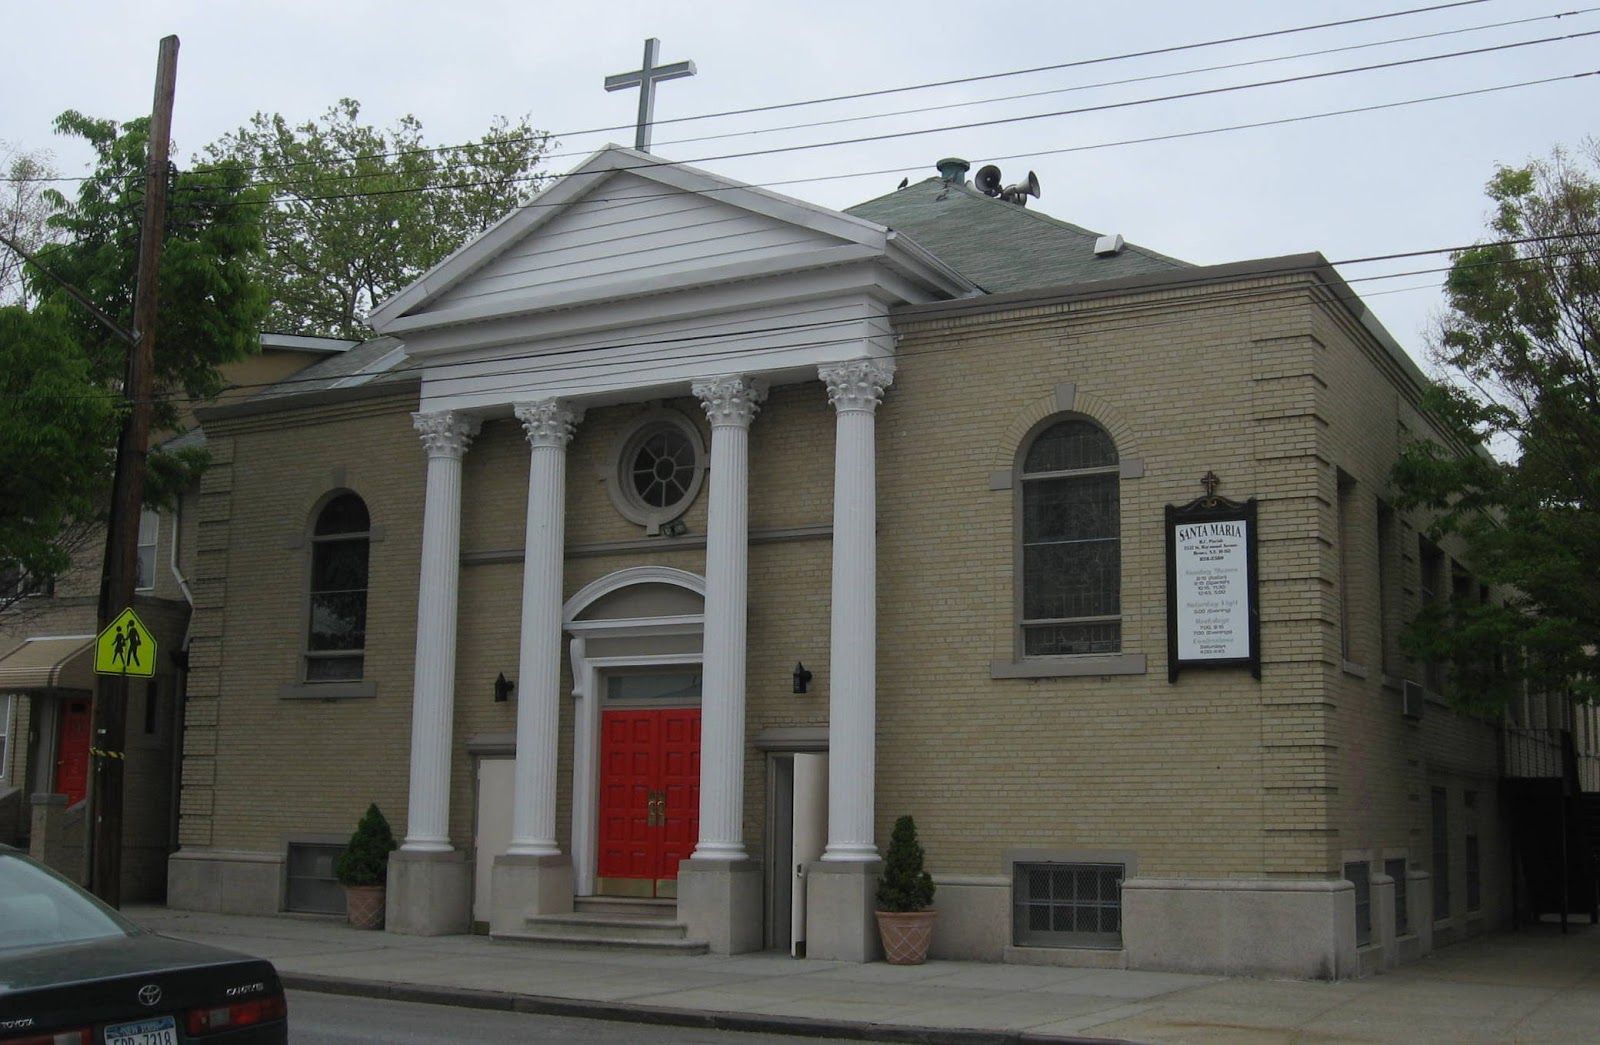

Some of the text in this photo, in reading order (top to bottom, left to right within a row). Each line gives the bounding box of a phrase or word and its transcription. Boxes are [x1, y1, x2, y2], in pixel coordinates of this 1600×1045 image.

[1179, 524, 1242, 542] SANTA MARIA
[0, 1018, 36, 1029] TOYOTA
